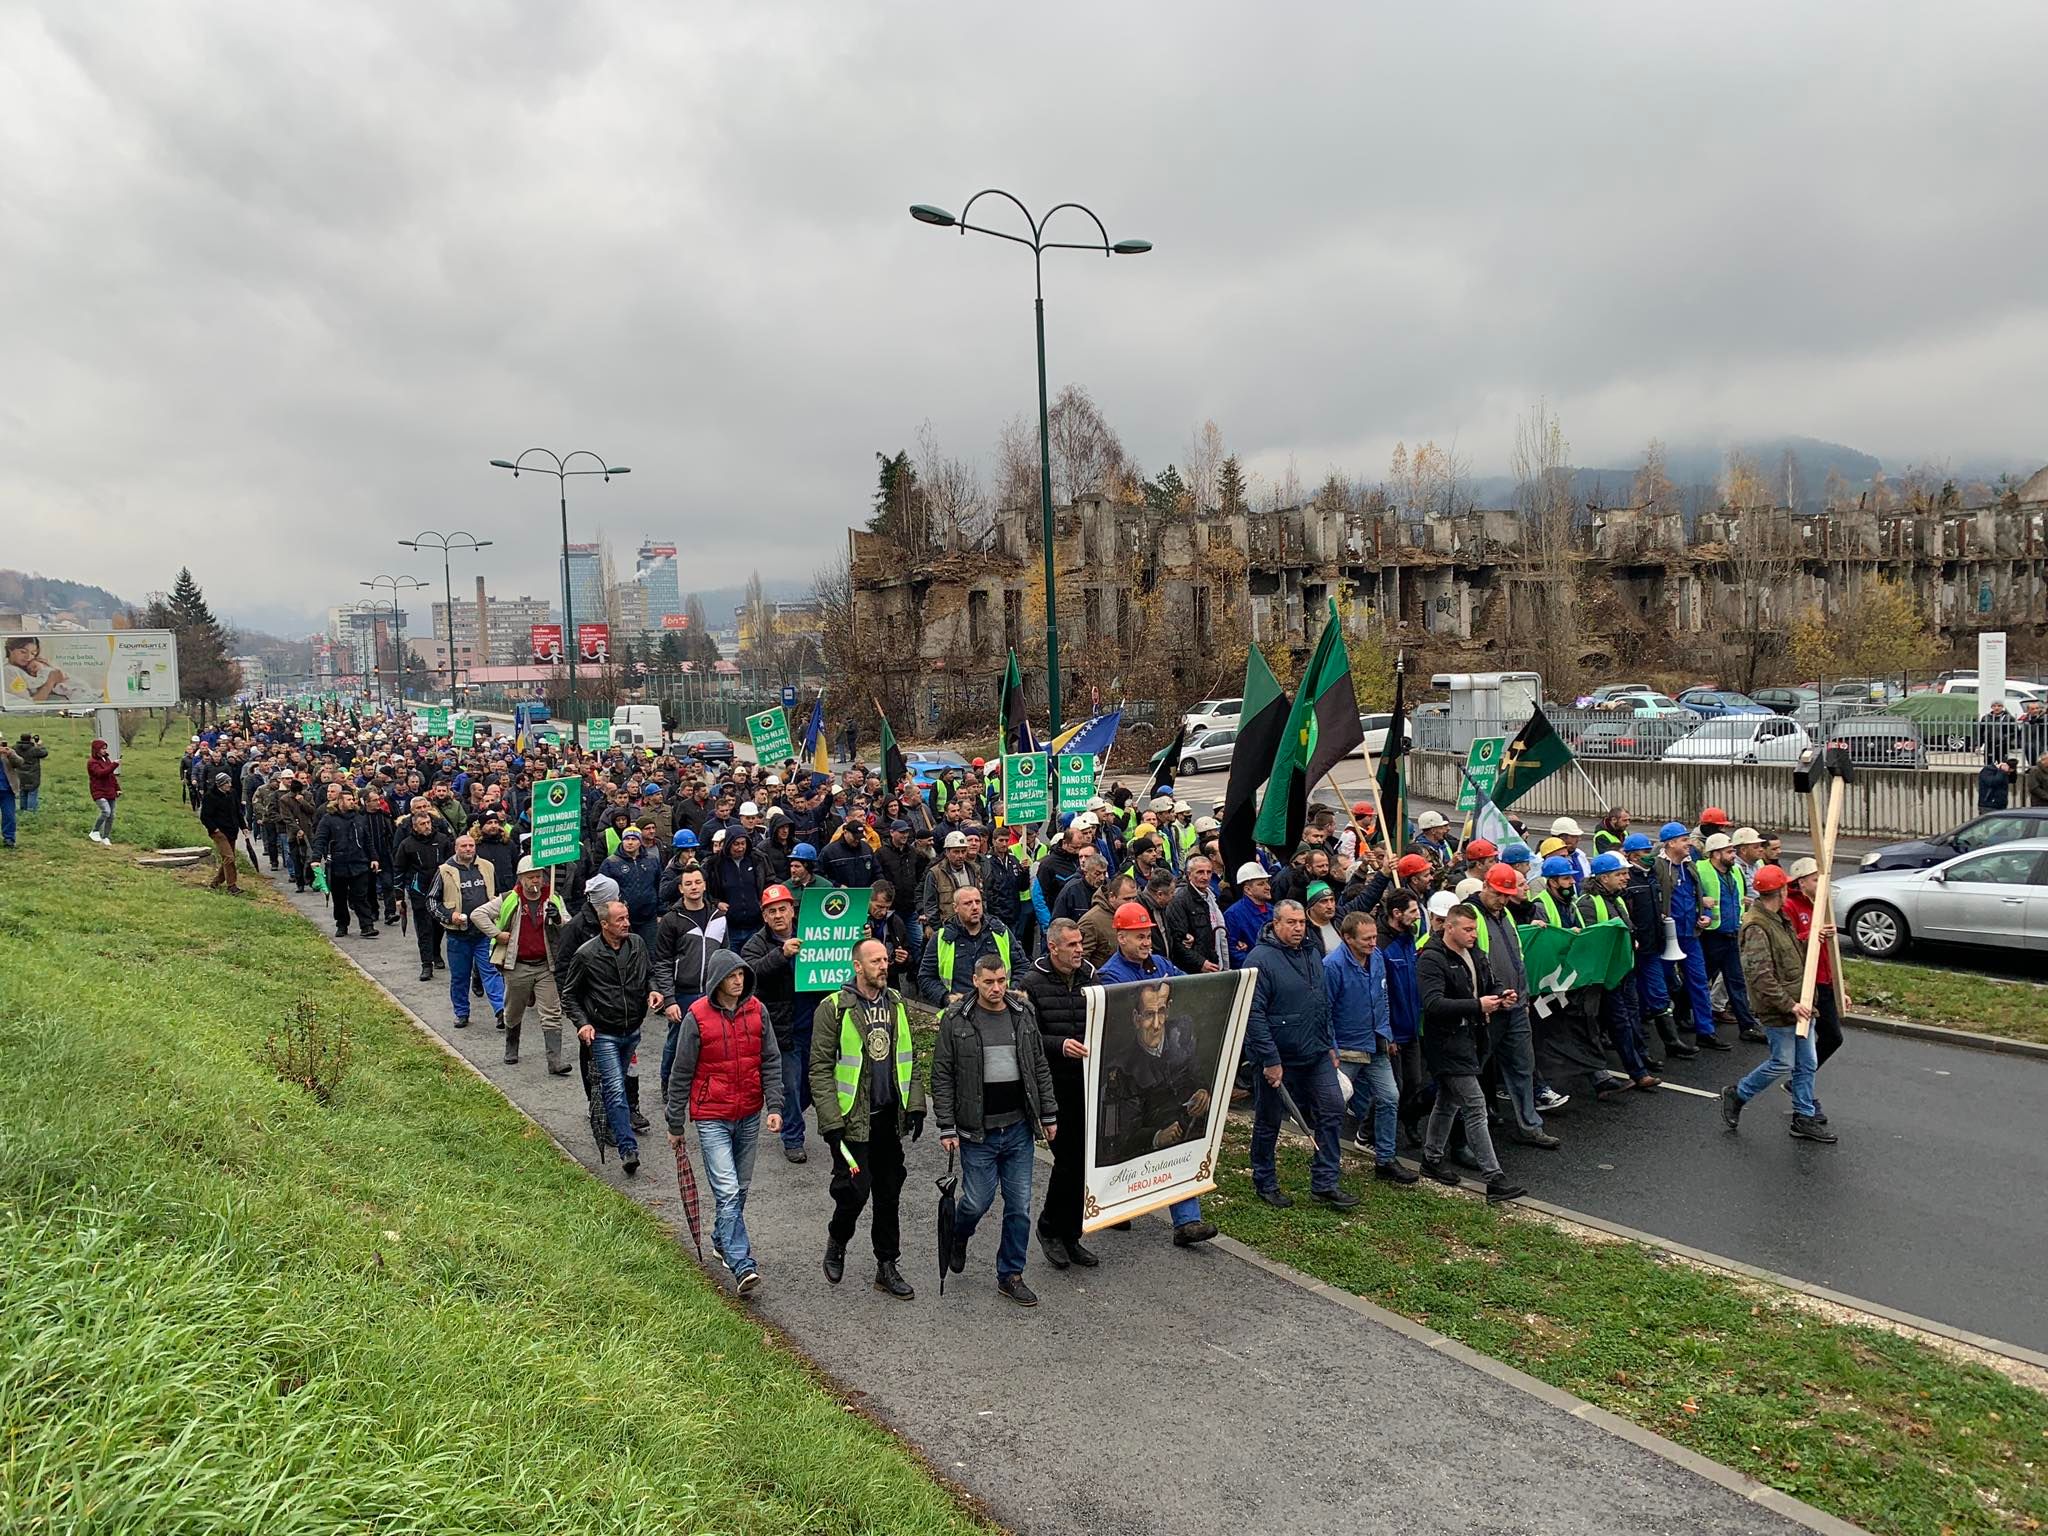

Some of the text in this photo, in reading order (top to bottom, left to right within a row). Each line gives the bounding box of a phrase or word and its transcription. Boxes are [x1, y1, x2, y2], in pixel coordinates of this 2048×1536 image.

[756, 728, 785, 744] NAS NIJE
[771, 749, 787, 760] VAS?
[1484, 764, 1497, 775] STE
[1016, 779, 1038, 789] MI SMO
[1061, 775, 1092, 784] RANO STE
[1010, 792, 1019, 801] ZA
[1066, 787, 1088, 796] NAS SE
[536, 810, 579, 824] AKO VI MORATE
[1025, 809, 1036, 818] VI?
[534, 825, 556, 836] PROTIV
[541, 838, 549, 846] MI
[805, 926, 860, 941] NAS NIJE
[807, 968, 852, 984] A VAS?
[1109, 1167, 1138, 1186] Alija
[1127, 1172, 1173, 1193] HEROJ RADA
